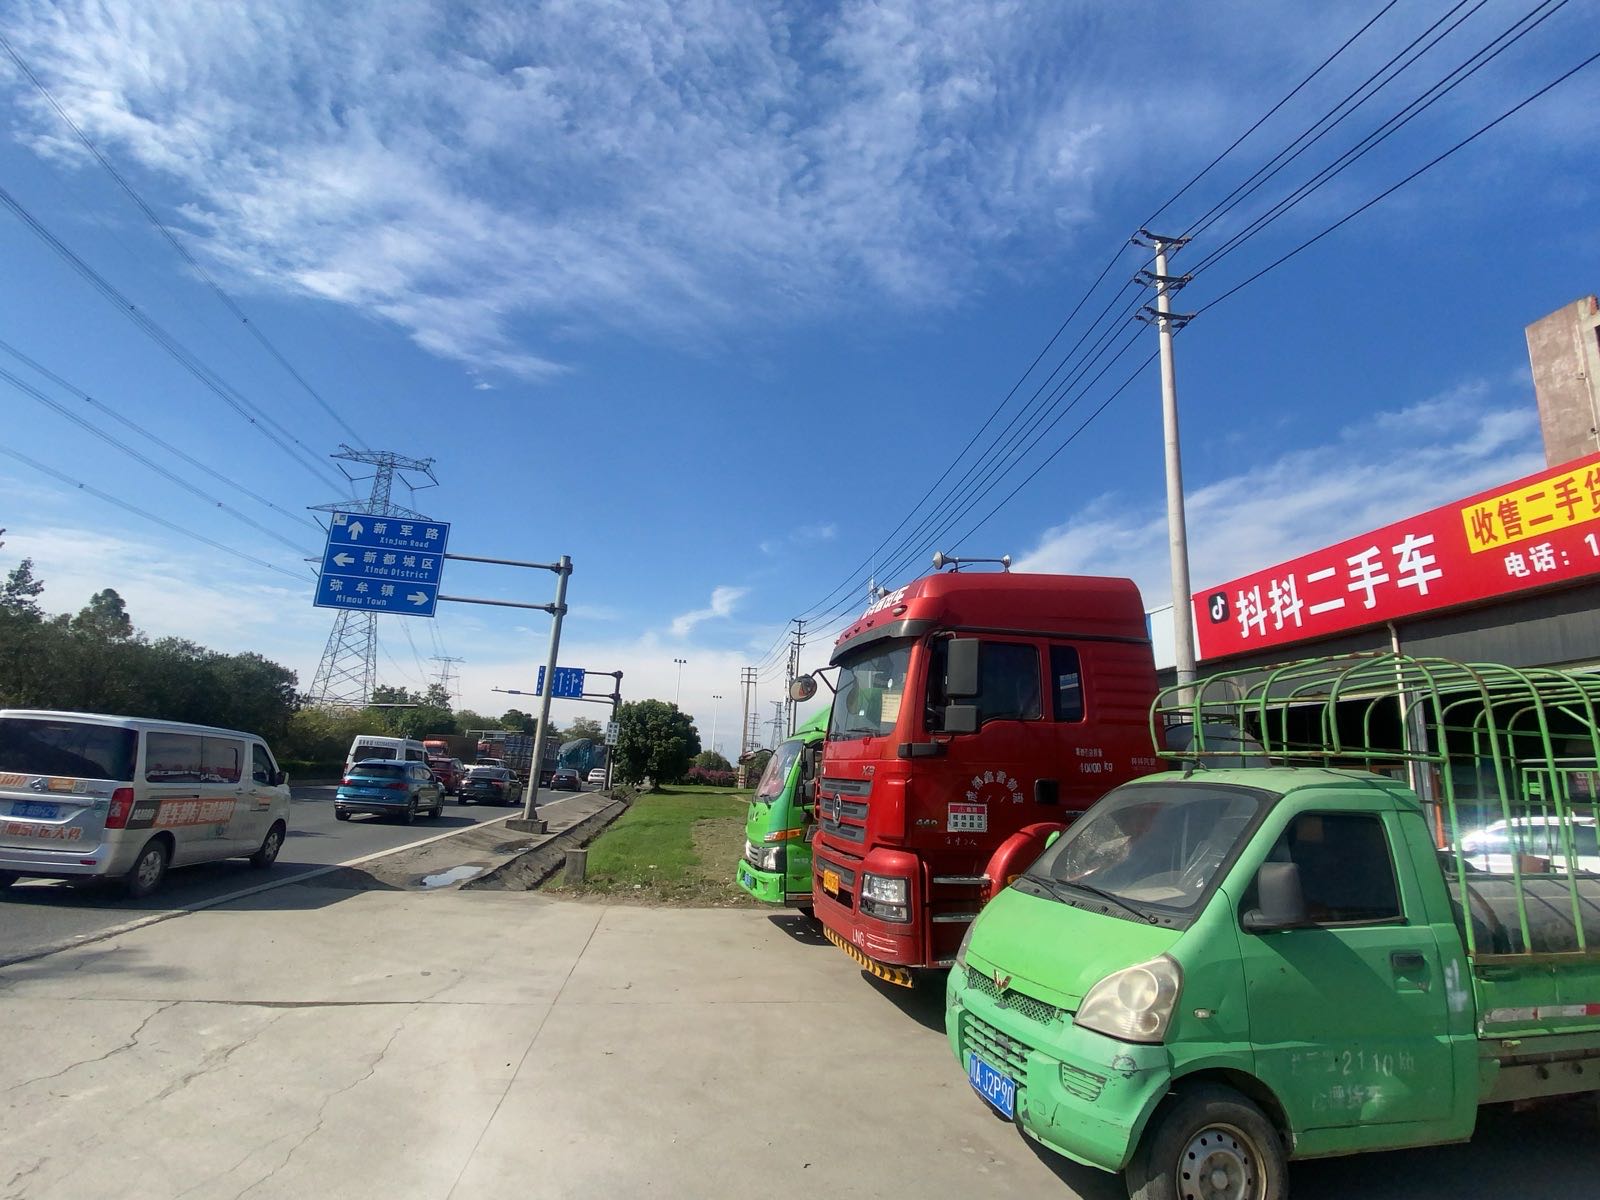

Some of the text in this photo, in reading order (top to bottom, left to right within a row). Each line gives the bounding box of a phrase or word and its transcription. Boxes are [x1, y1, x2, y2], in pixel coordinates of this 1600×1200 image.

[373, 522, 439, 540] 新军路
[363, 551, 434, 570] 新都城区
[364, 566, 428, 579] Xindu District
[329, 579, 395, 597] 弥牟镇
[1235, 533, 1443, 639] 抖抖二手车
[335, 594, 387, 606] Mimou Town
[852, 928, 865, 947] LNG
